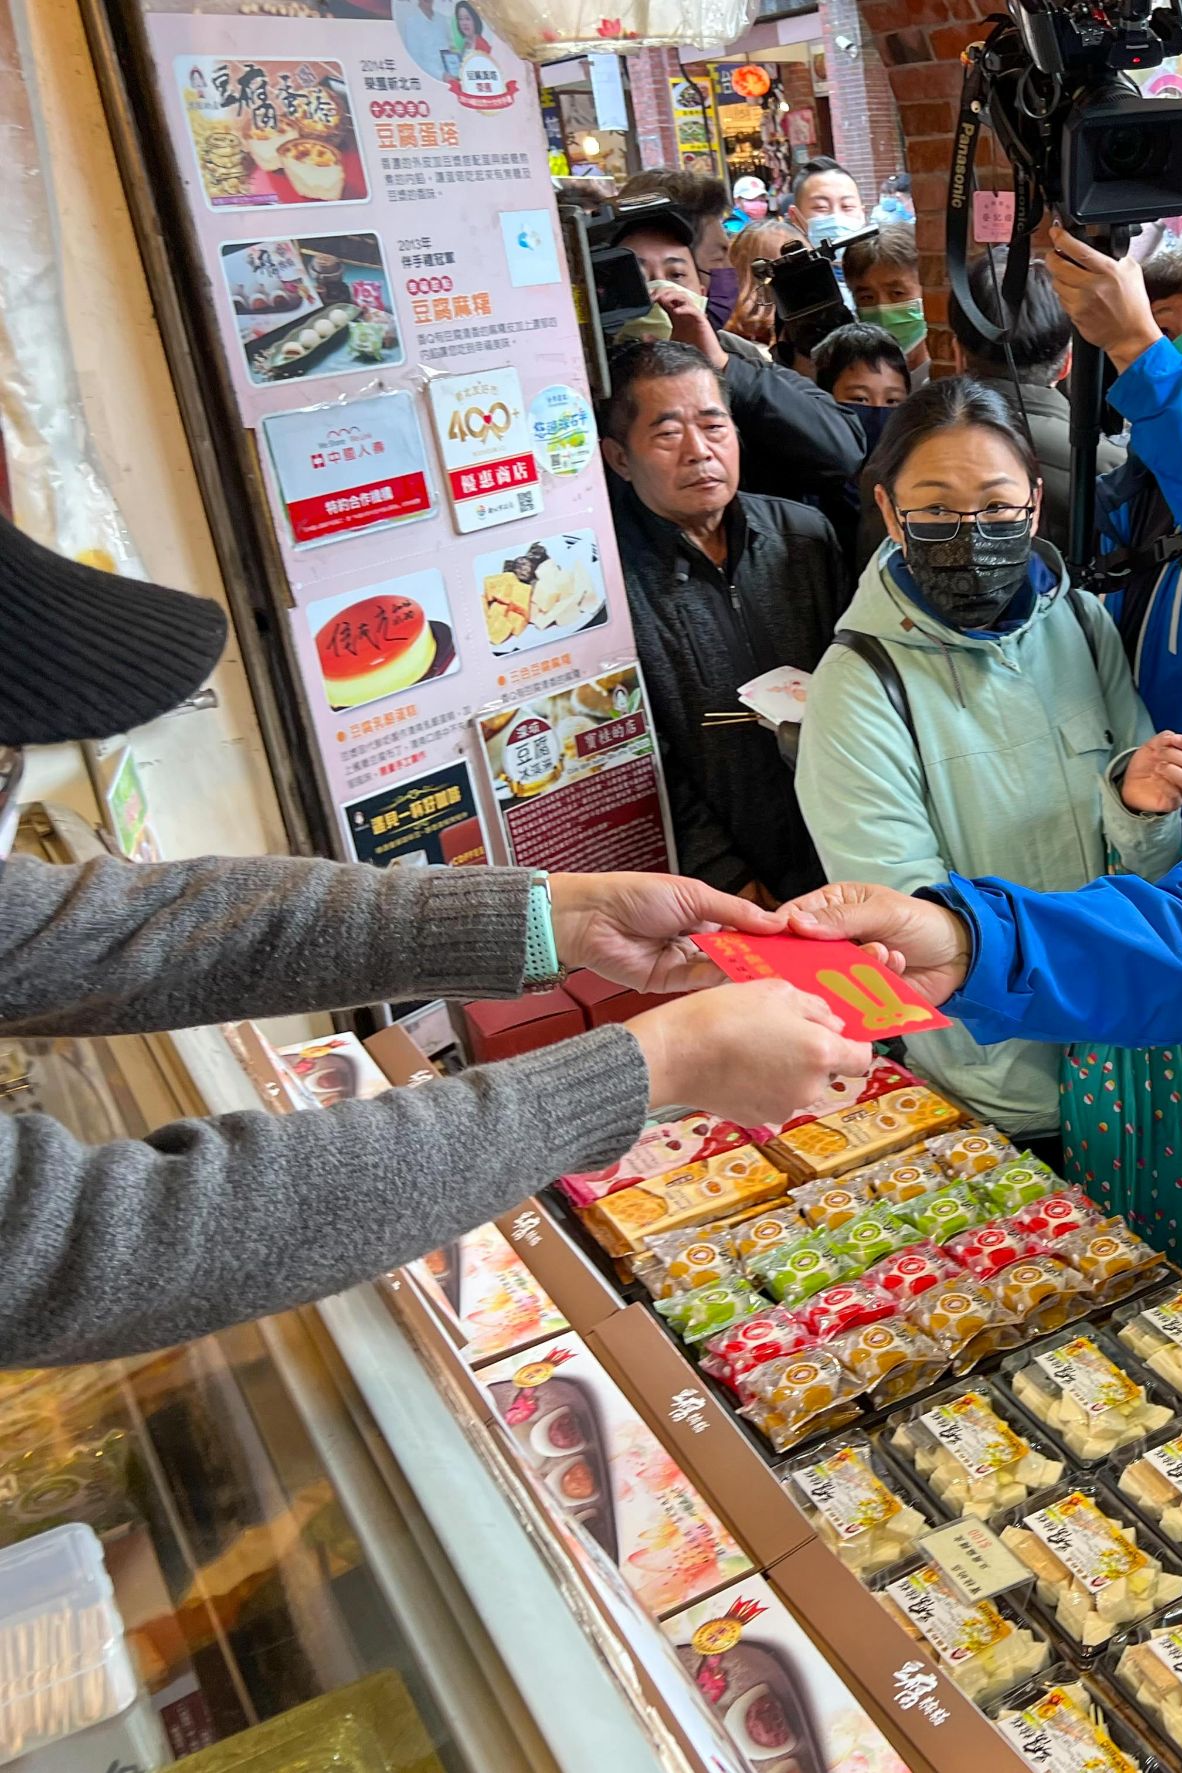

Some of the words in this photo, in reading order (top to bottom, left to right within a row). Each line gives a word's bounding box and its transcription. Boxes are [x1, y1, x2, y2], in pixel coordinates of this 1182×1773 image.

[374, 121, 460, 150] 豆腐蛋塔
[951, 122, 976, 209] Panasonic
[410, 291, 492, 325] 豆腐麻糬
[328, 441, 385, 464] 中國人壽
[460, 461, 528, 495] 優惠商店
[324, 486, 394, 515] 特約合作機構
[583, 719, 638, 750] 寶桂的店
[371, 785, 462, 835] 遇見一杯好咖啡
